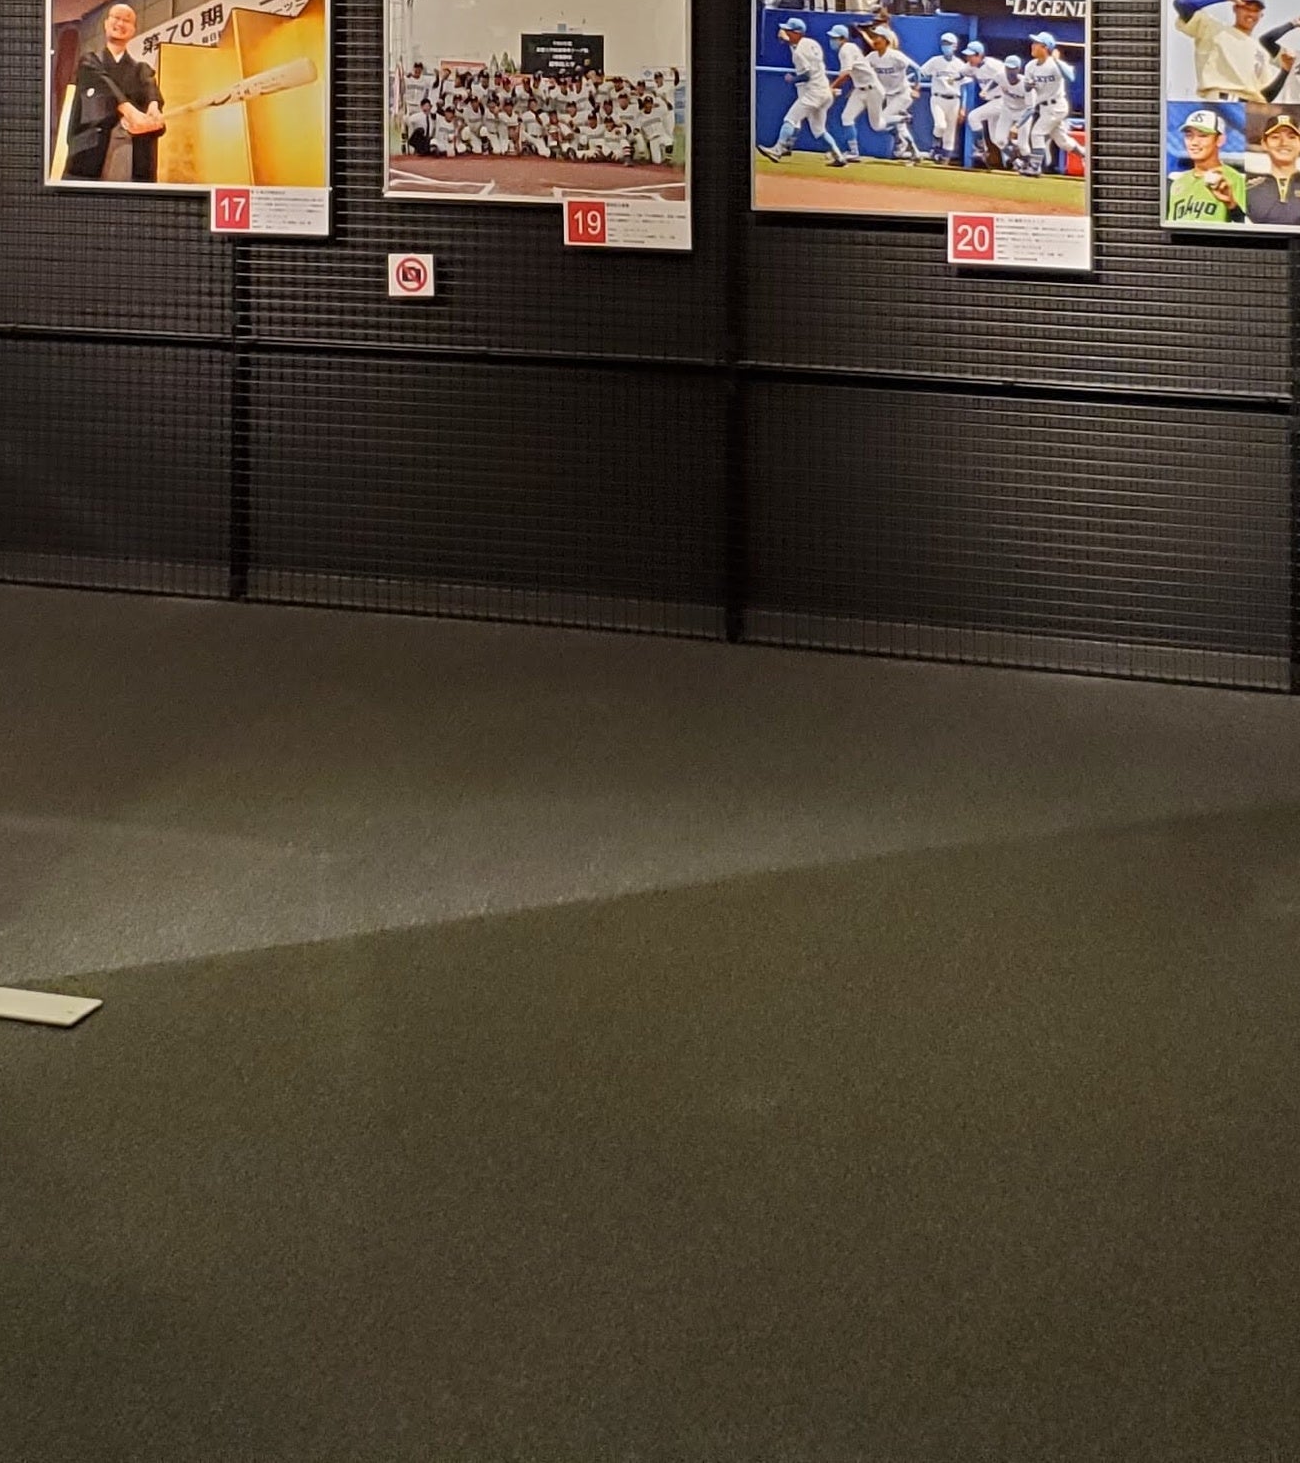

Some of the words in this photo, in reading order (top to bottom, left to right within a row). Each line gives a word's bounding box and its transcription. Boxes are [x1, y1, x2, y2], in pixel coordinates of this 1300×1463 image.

[201, 30, 222, 44] 毎日
[220, 196, 246, 222] 17
[1174, 195, 1218, 221] Tokyo
[573, 209, 602, 235] 19
[956, 224, 990, 252] 20
